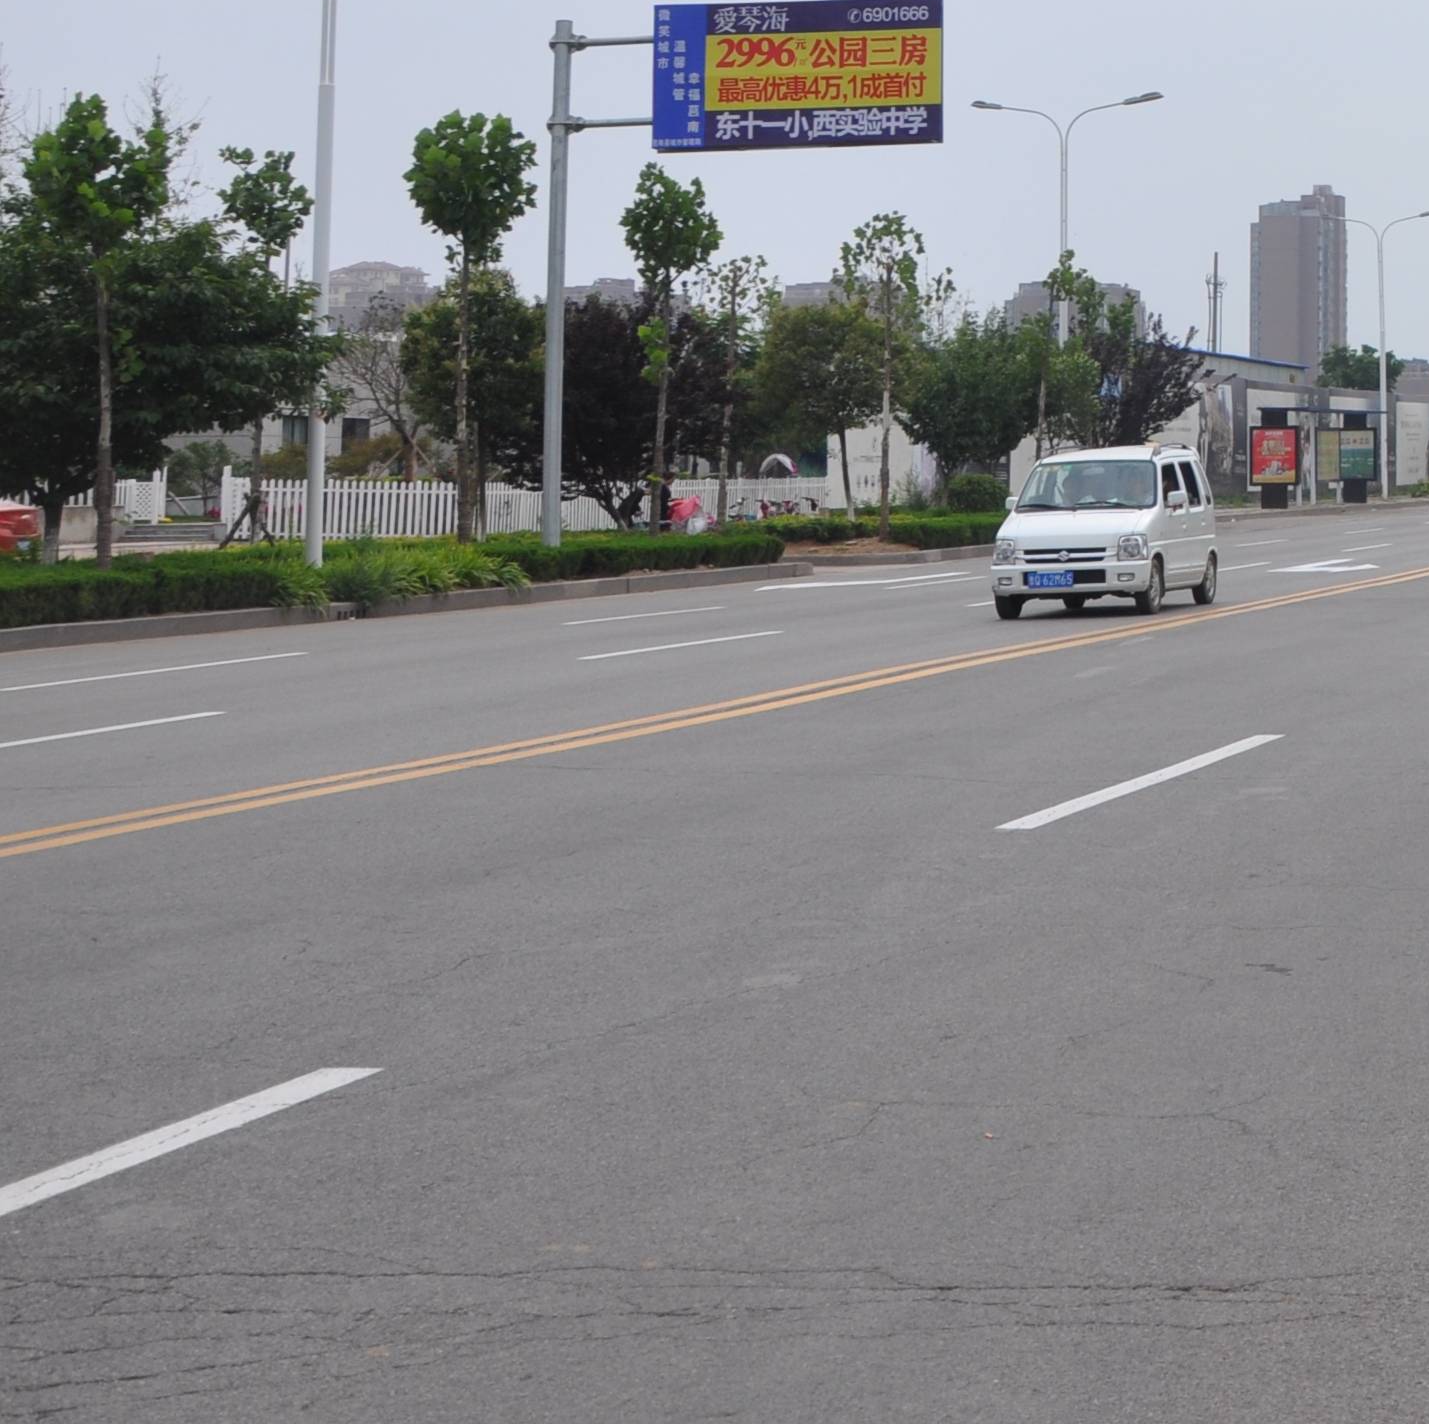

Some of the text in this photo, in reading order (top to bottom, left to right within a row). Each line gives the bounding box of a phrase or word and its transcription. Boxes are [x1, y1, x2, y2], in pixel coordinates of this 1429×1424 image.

[862, 6, 929, 23] 6901666
[809, 35, 928, 69] 公园三房
